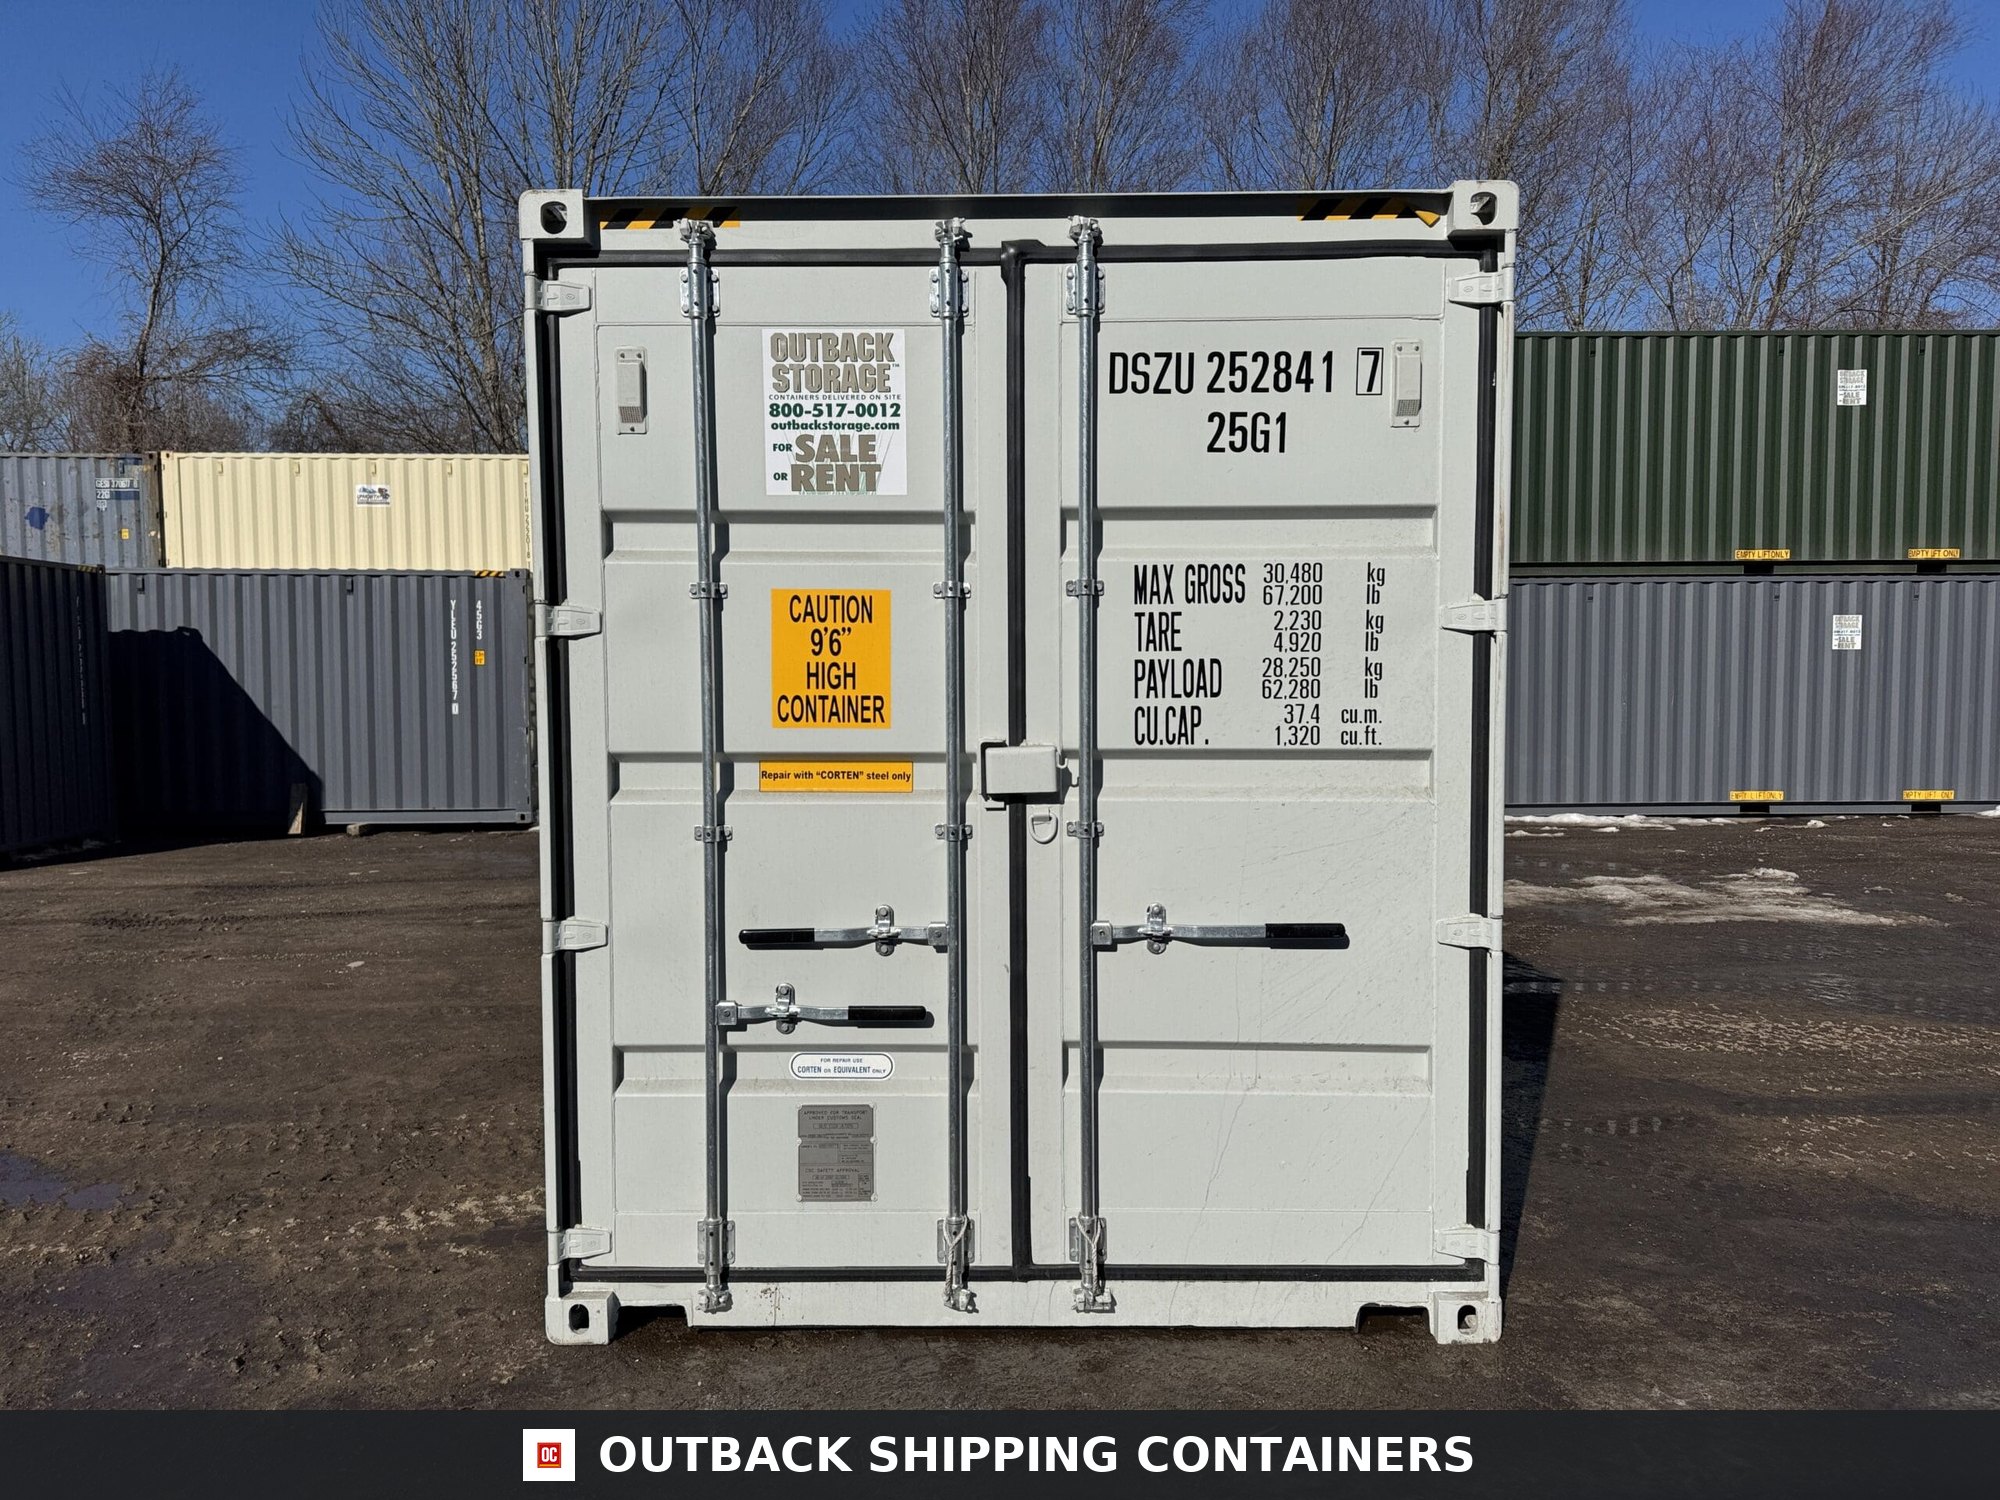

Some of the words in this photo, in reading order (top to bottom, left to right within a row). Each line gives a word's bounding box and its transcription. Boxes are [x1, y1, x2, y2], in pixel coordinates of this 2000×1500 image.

[771, 333, 895, 362] OUTBACK
[772, 364, 891, 392] STORAGE
[1109, 352, 1194, 394] DSZU
[1207, 351, 1333, 393] 252841
[1360, 350, 1380, 393] 7
[769, 403, 900, 417] 800-517-0012
[771, 419, 899, 432] outbackstorage.com
[1207, 412, 1286, 453] 25G1
[773, 444, 792, 452] FOR
[795, 434, 876, 463] SALE
[773, 472, 787, 480] OR
[791, 464, 881, 492] RENT
[1134, 564, 1174, 604] MAX
[1185, 564, 1245, 604] GROSS
[1367, 562, 1385, 586] kg
[1367, 585, 1380, 604] lb
[790, 595, 872, 623] CAUTION
[1365, 610, 1384, 633] kg
[1134, 612, 1182, 652] TARE
[1365, 633, 1379, 651] lb
[807, 662, 856, 690] HIGH
[1135, 658, 1222, 699] PAYLOAD
[1364, 657, 1383, 680] kg
[1365, 679, 1378, 698] lb
[778, 695, 885, 723] CONTAINER
[1284, 704, 1319, 724] 37.4
[1341, 709, 1382, 723] cu.m.
[1275, 726, 1320, 746] 1,320
[1341, 727, 1382, 746] cu.ft.
[762, 770, 790, 782] Repair
[794, 771, 813, 779] with
[867, 771, 889, 780] steel
[892, 770, 911, 782] only
[798, 1066, 821, 1074] CORTEN
[833, 1066, 870, 1074] EQUIVALENT
